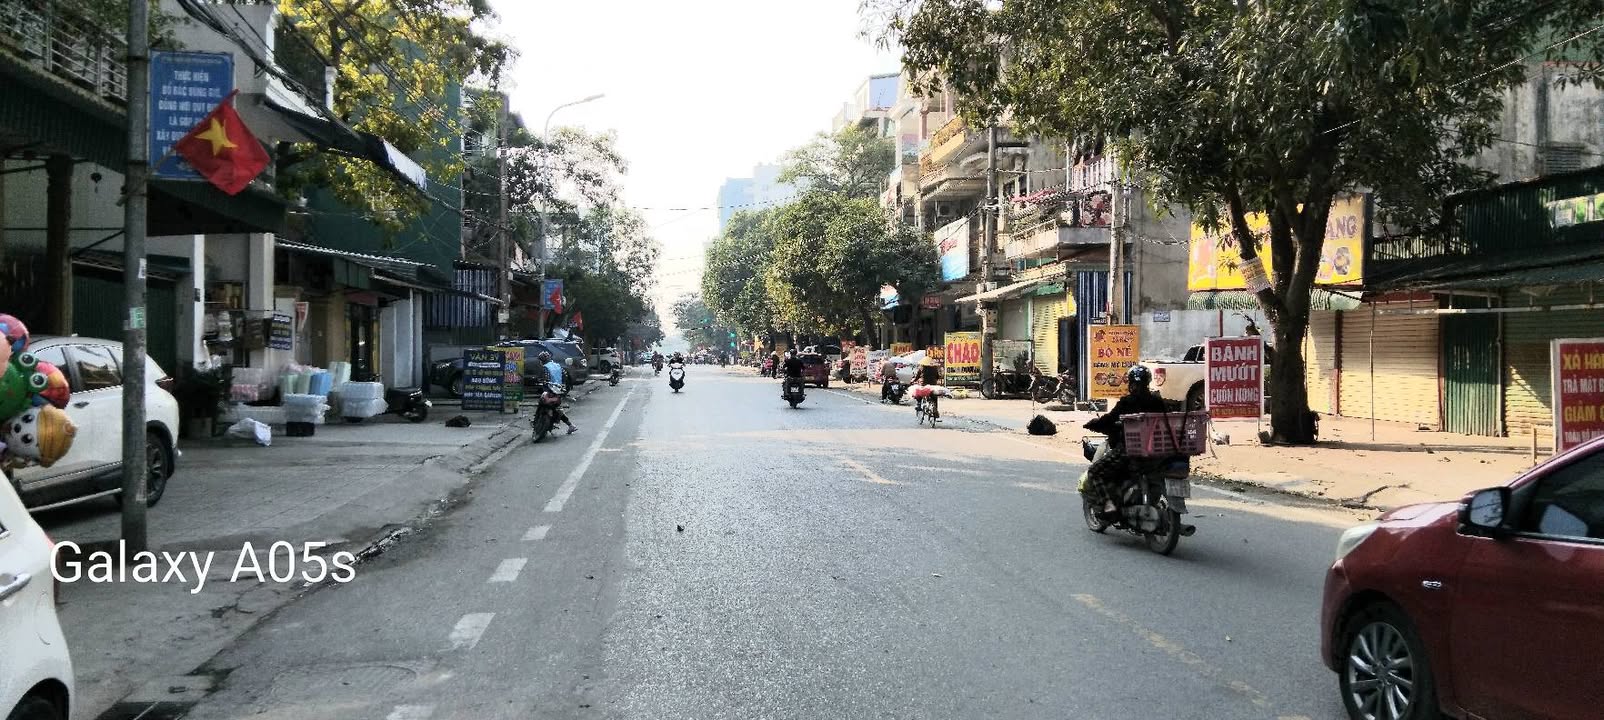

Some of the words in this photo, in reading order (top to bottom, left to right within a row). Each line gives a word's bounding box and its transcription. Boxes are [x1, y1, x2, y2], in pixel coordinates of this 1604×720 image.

[1211, 343, 1257, 362] BÁNH
[1563, 349, 1581, 370] XẢ
[1210, 362, 1259, 382] MƯỚT
[1210, 383, 1233, 404] CUỐN
[1562, 374, 1578, 394] TRẢ
[1580, 375, 1597, 396] MẶT
[1564, 400, 1596, 423] GIẢM
